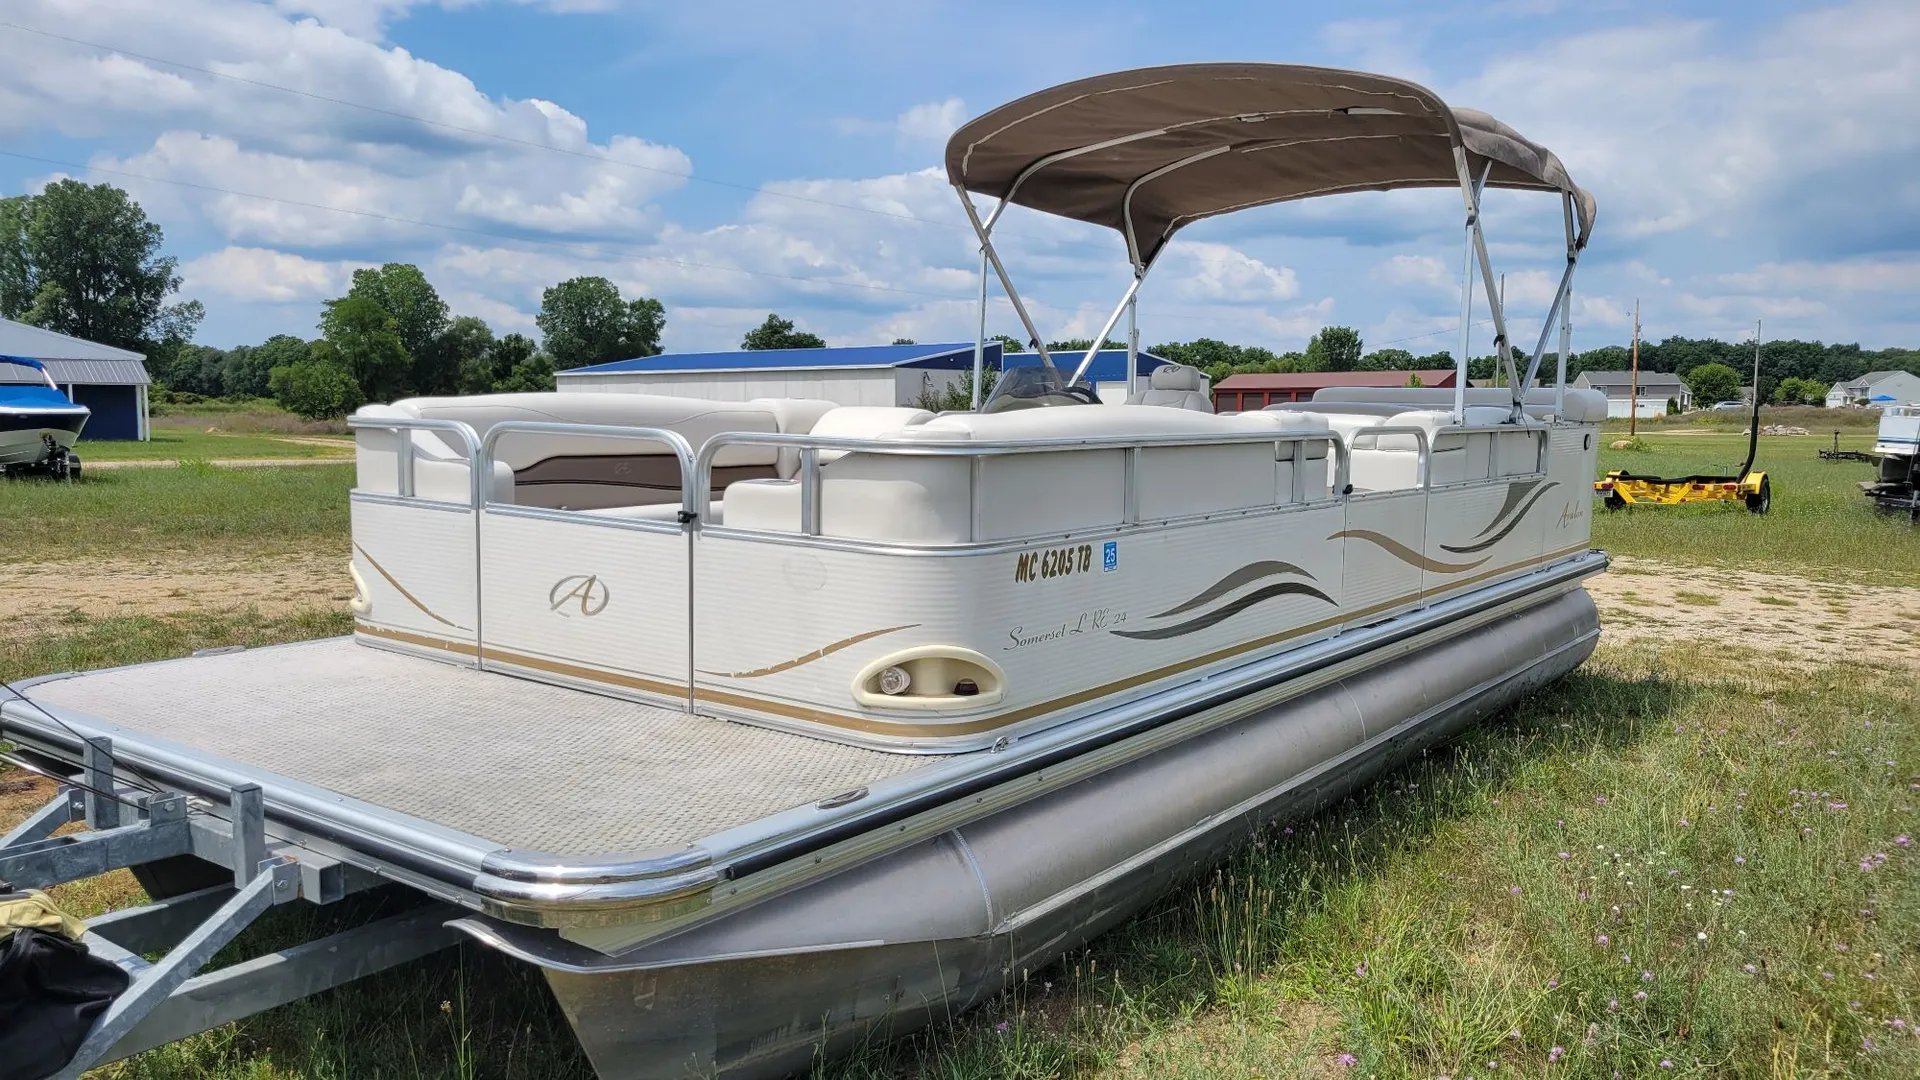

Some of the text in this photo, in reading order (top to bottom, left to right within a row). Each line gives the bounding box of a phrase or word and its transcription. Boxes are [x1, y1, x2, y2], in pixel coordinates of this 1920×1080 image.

[1105, 548, 1116, 563] 25
[1015, 544, 1092, 583] MC 6205 TB
[1113, 611, 1127, 625] 24
